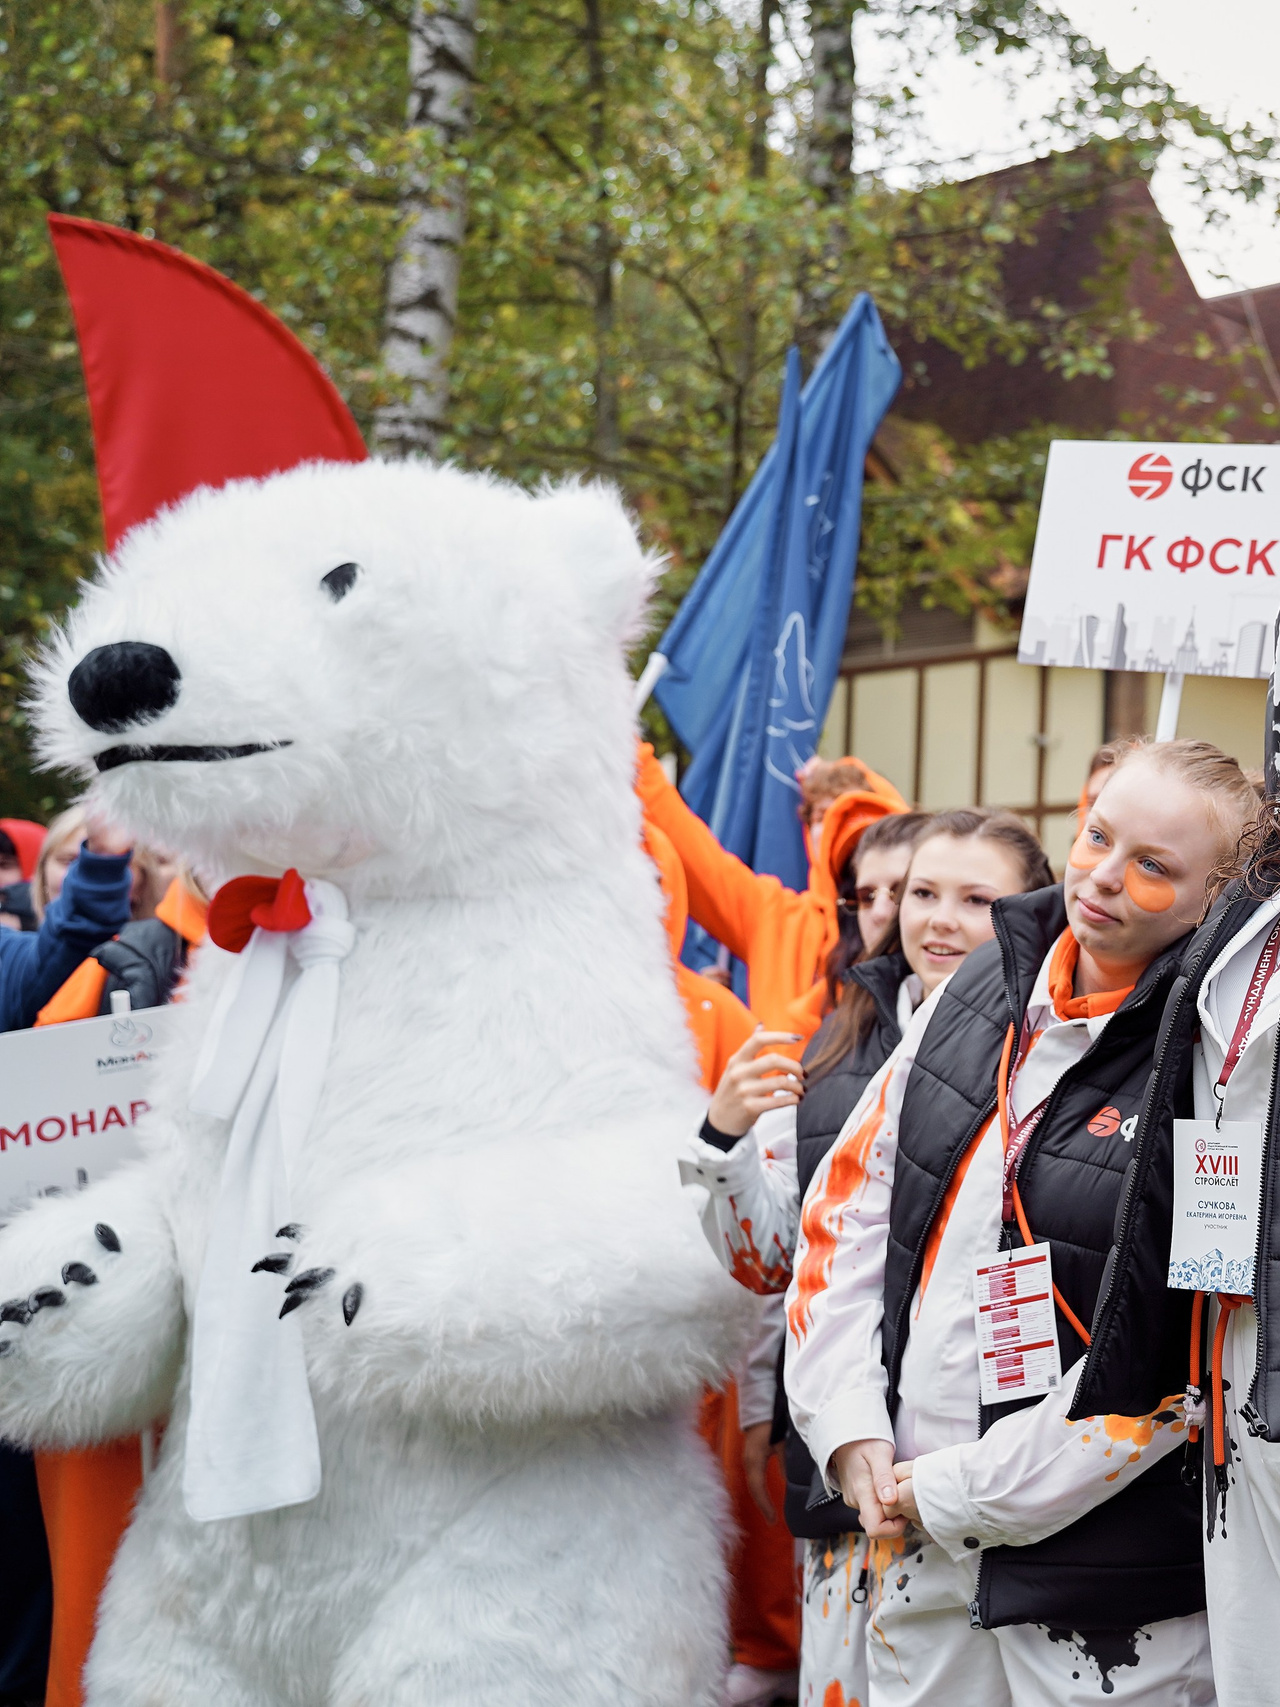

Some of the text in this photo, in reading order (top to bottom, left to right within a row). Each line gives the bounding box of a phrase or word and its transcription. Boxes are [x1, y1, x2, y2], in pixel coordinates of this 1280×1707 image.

[1181, 458, 1267, 497] ФСК
[1097, 534, 1279, 576] ГК ФСК
[0, 1099, 151, 1152] МОНАР
[1195, 1154, 1239, 1175] XVIII
[1186, 1211, 1248, 1221] ЕКАТЕРИНА ИГОРЕВНА
[1197, 1200, 1236, 1210] СУЧКОВА
